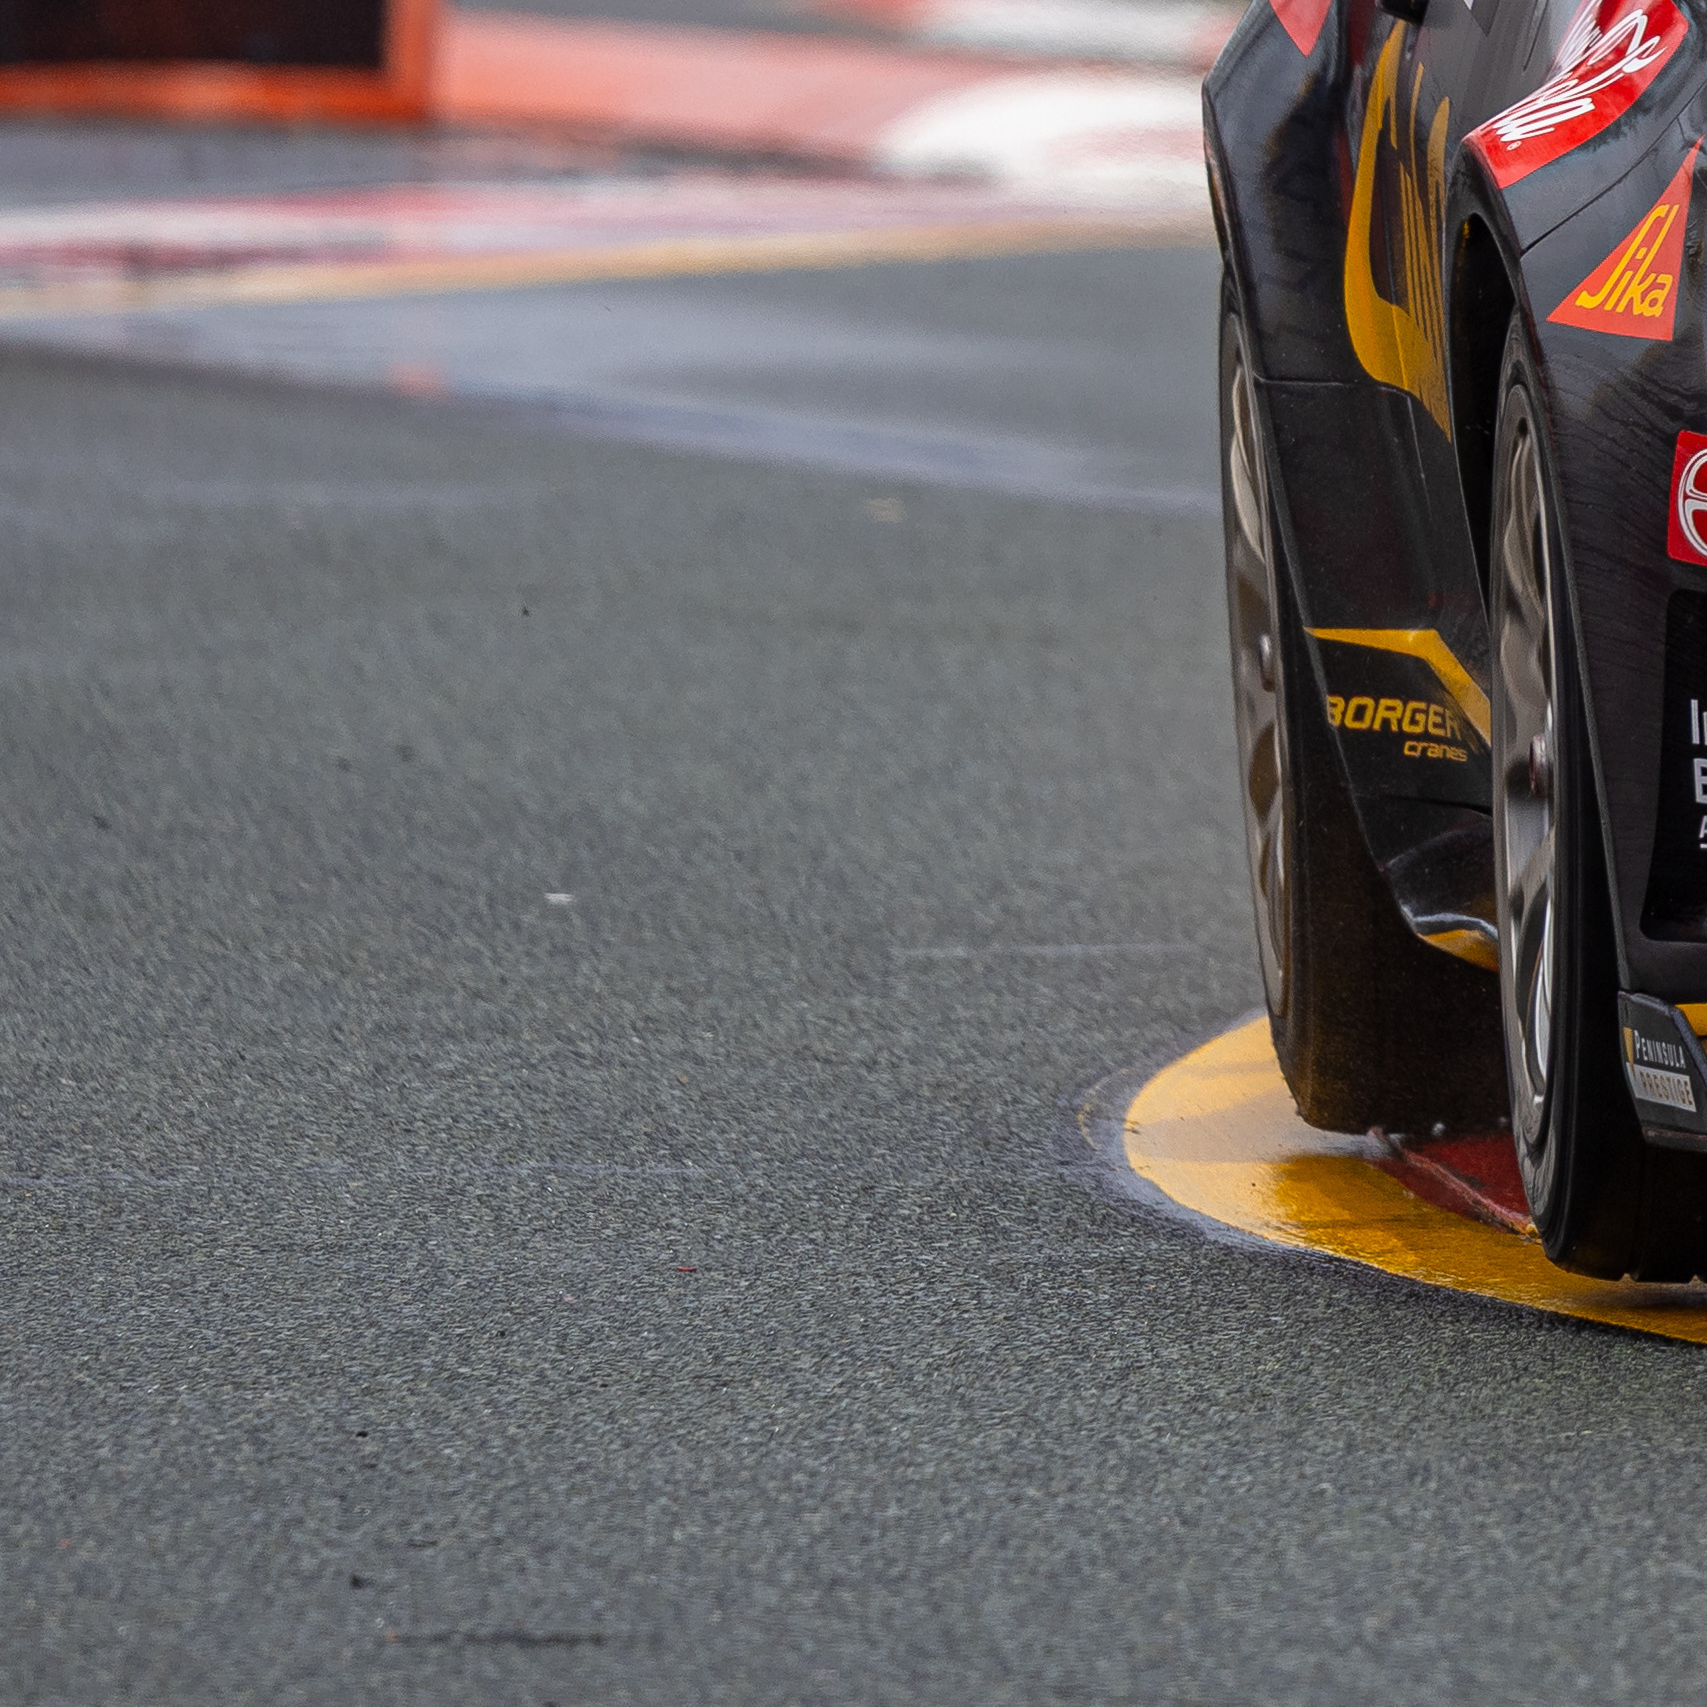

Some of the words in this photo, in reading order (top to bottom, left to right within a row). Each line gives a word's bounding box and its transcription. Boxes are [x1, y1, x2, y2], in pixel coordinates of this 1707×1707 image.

[1575, 203, 1680, 318] Sika
[1633, 1029, 1686, 1069] PENINSULA
[1639, 1070, 1694, 1106] PRESTIGE
